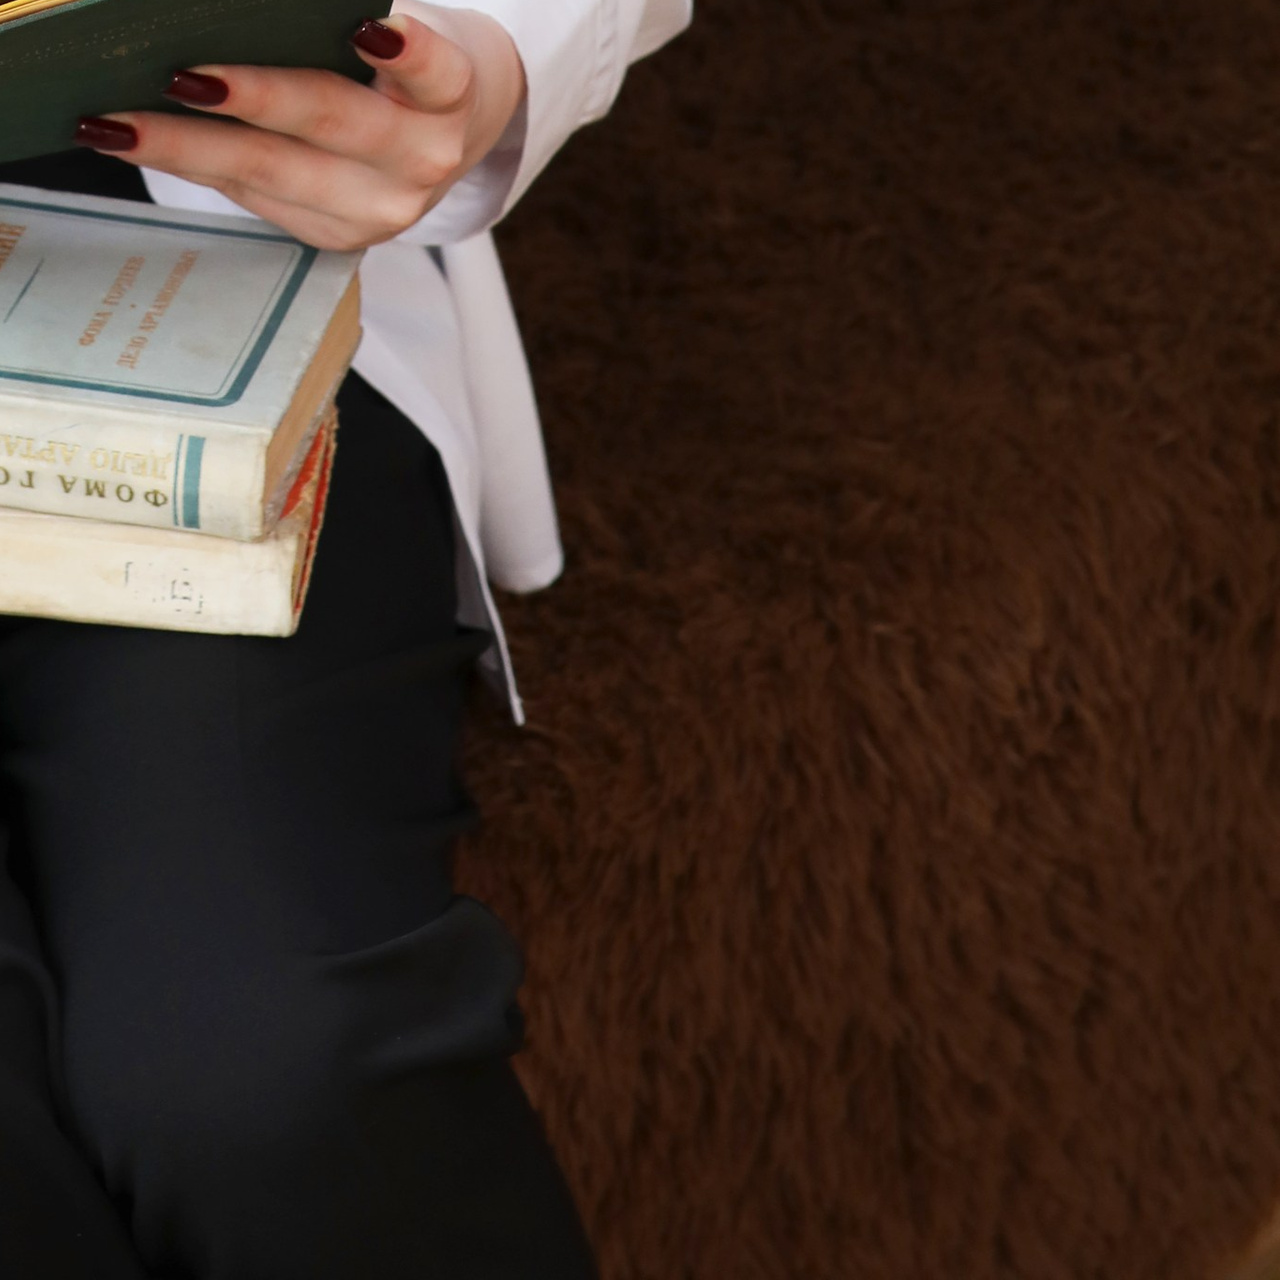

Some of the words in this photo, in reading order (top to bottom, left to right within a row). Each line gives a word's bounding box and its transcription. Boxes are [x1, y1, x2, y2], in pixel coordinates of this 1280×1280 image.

[78, 311, 113, 347] ФОМА
[102, 255, 147, 307] ГОРДЕЕВ
[116, 335, 149, 370] ДЕЛО
[138, 249, 203, 333] АРТАМОНОВЫХ
[58, 474, 169, 507] ФОМА
[89, 448, 173, 480] ДЕЛО
